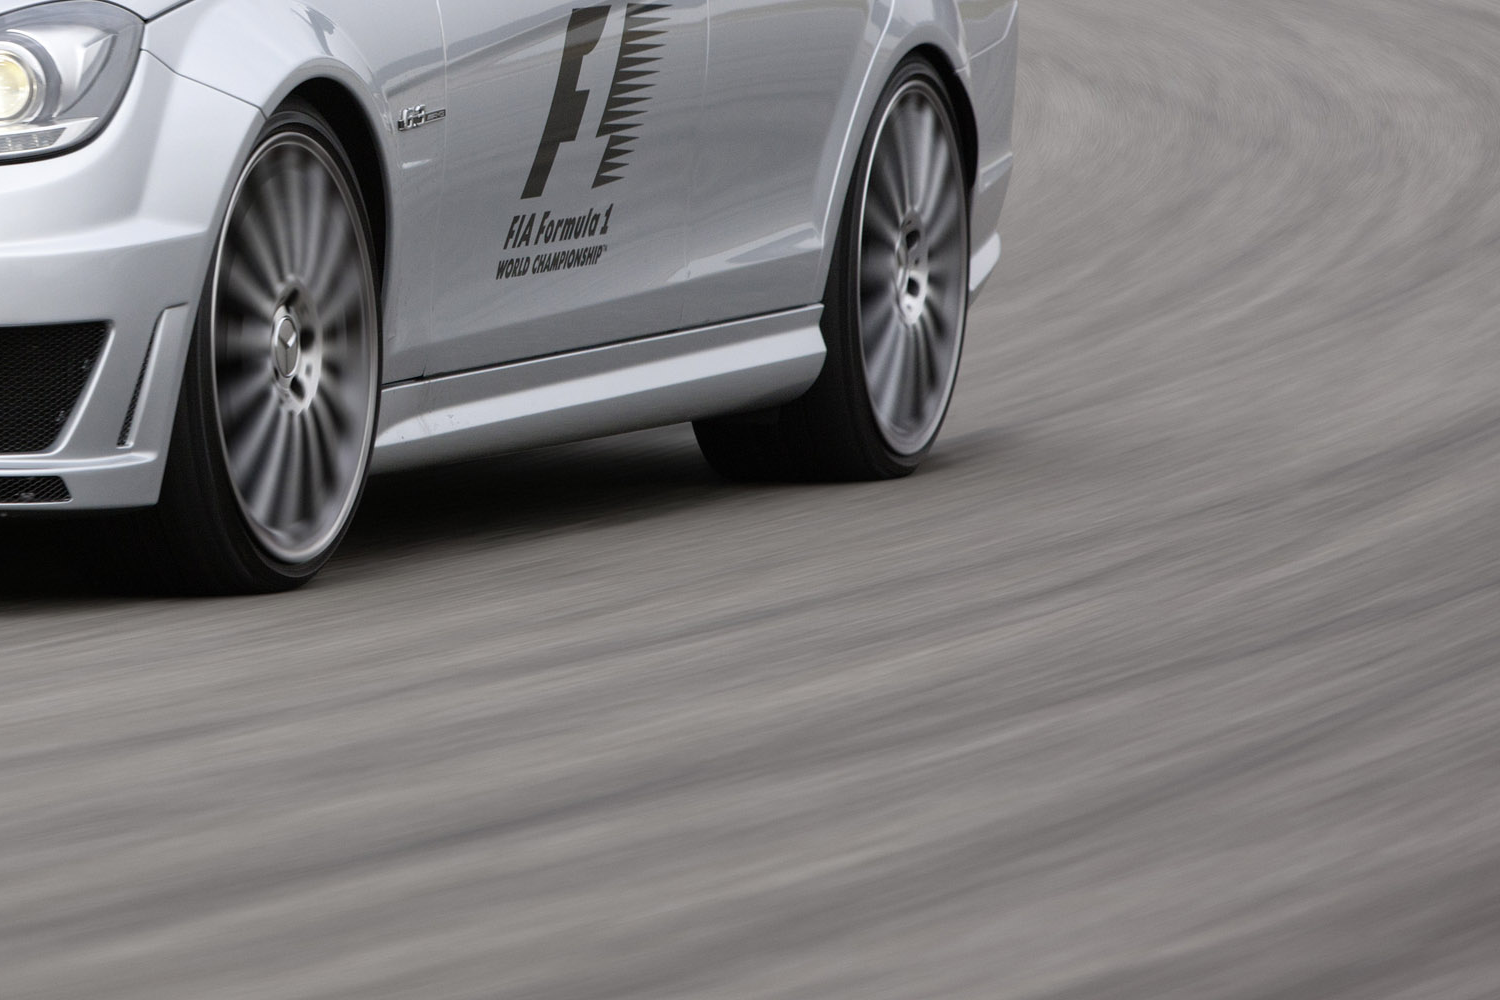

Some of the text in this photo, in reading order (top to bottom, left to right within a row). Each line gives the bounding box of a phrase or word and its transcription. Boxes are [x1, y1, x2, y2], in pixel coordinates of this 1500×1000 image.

[503, 202, 614, 250] FIA Formula 1
[496, 256, 531, 281] WORLD
